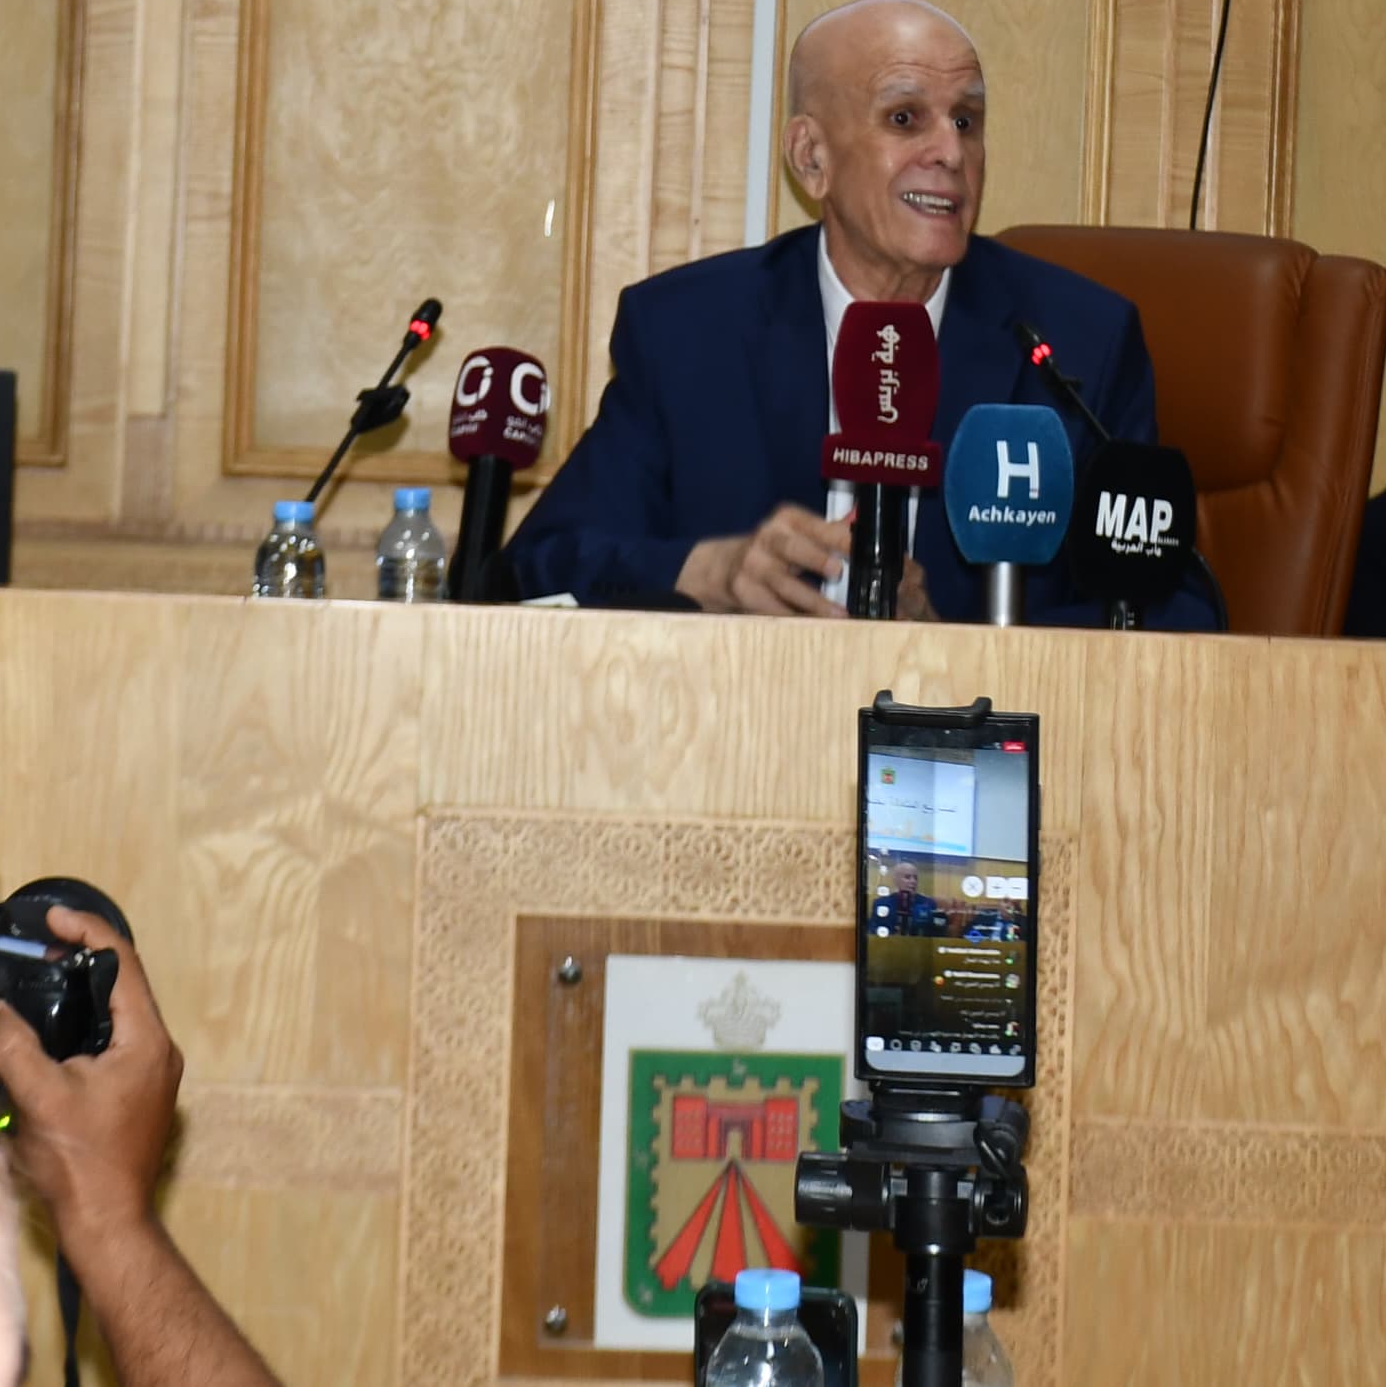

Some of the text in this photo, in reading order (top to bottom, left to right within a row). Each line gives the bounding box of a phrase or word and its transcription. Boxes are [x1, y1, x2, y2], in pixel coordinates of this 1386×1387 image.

[832, 447, 929, 471] HIBAPRESS
[968, 504, 1056, 527] Achkayen
[1095, 490, 1174, 544] MAP
